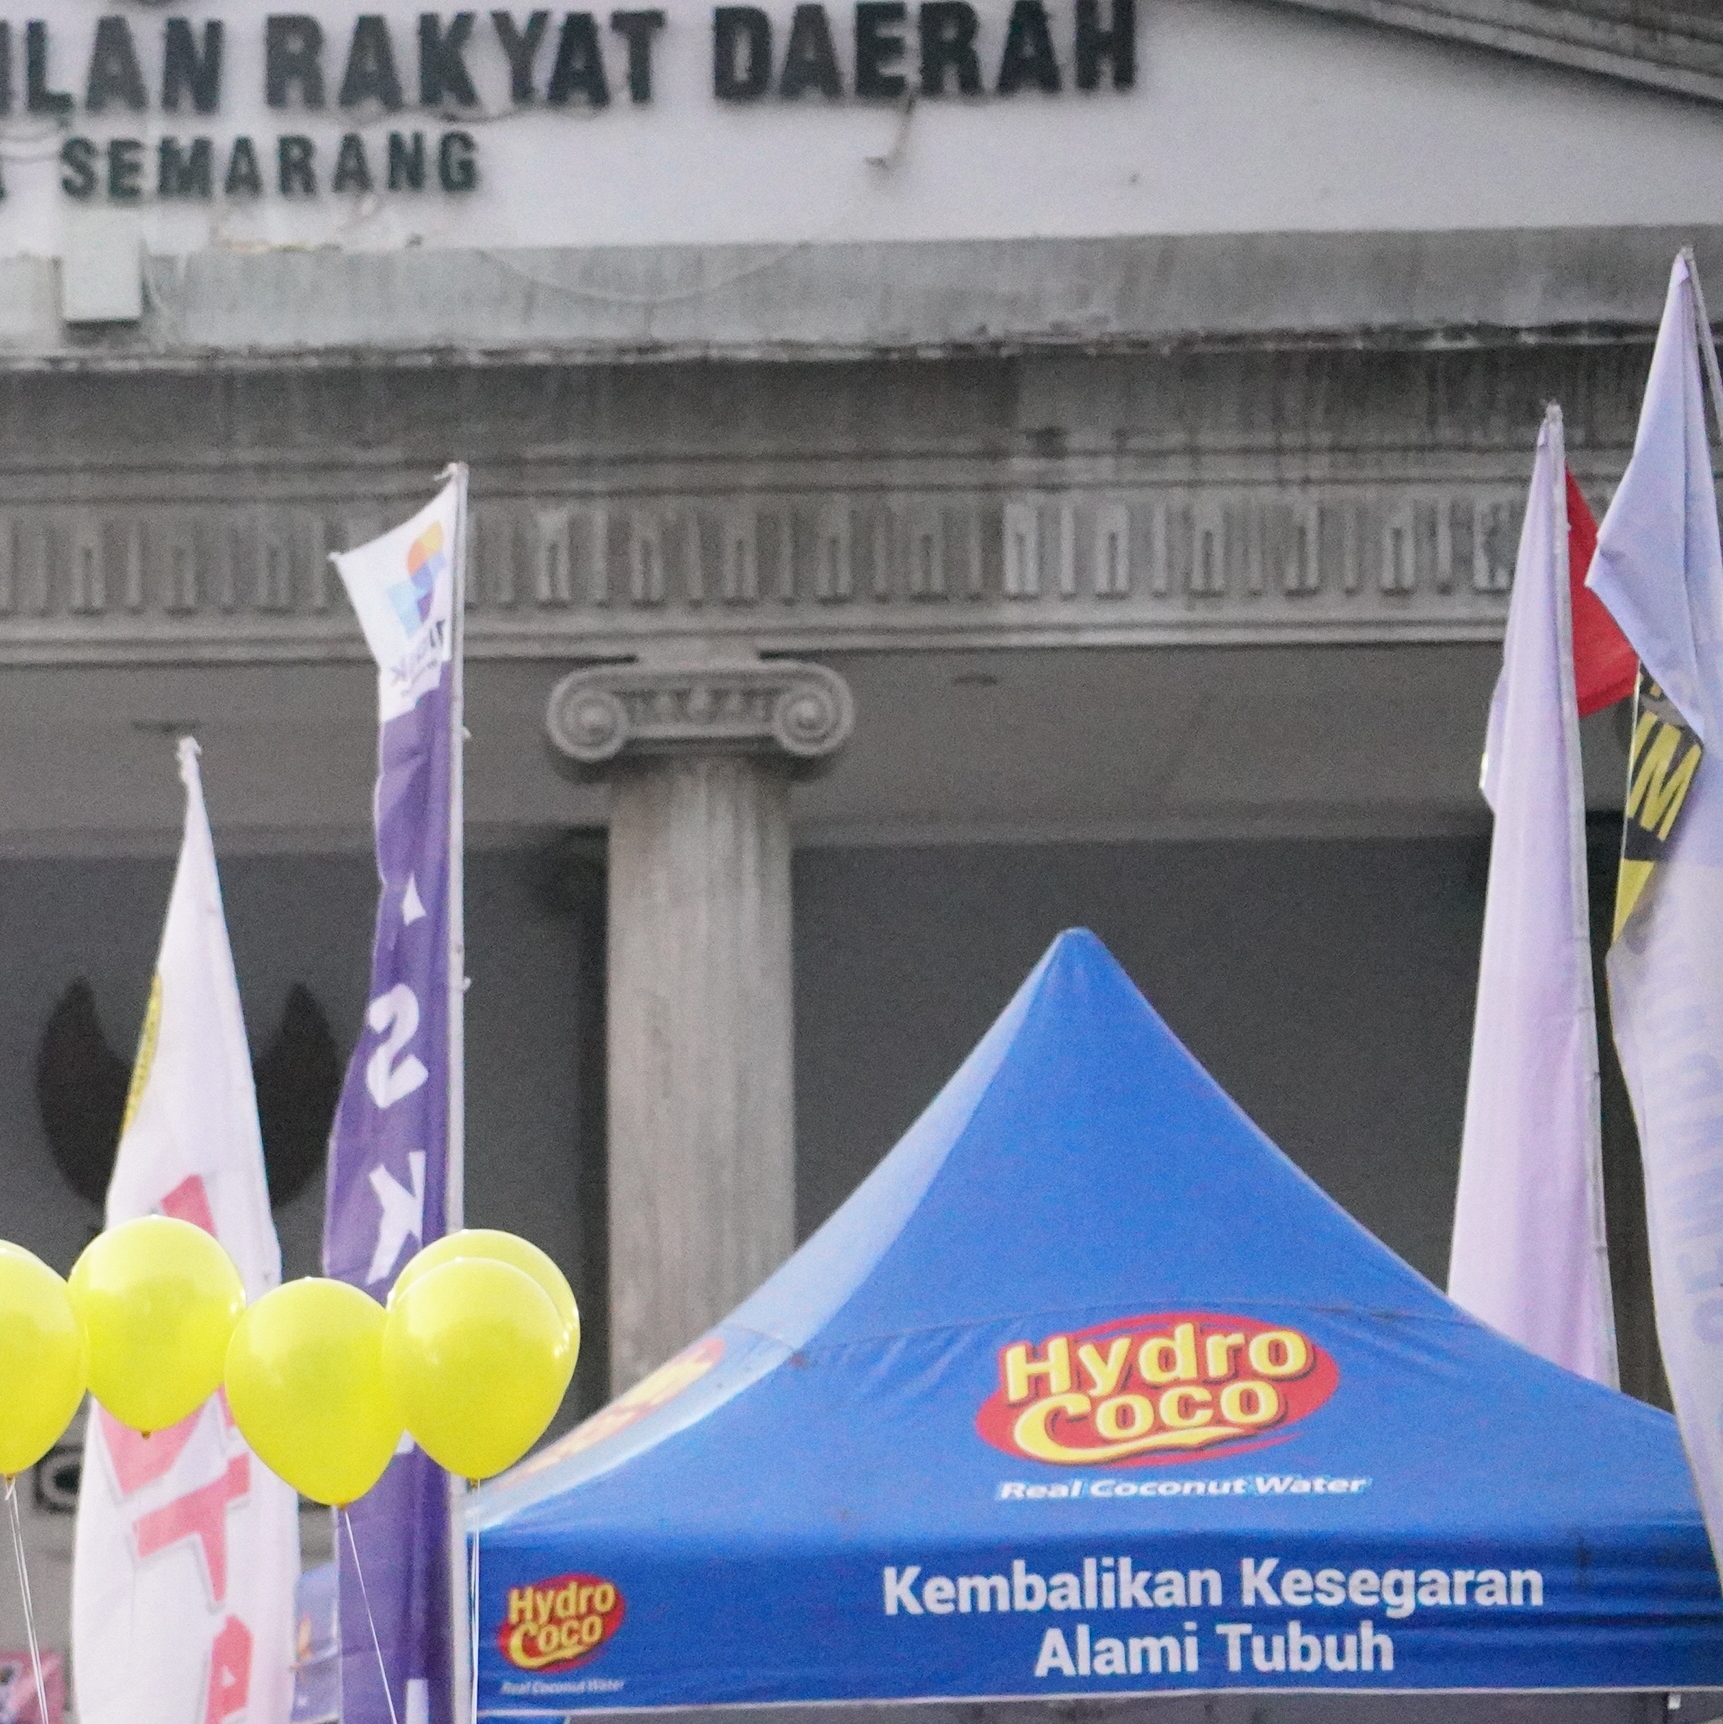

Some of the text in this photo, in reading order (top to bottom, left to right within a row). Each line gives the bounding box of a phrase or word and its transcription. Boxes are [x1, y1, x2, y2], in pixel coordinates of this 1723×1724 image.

[263, 9, 666, 113] RAKYAT
[712, 1, 1139, 102] DAERAH
[60, 129, 478, 202] SEMARANG
[1005, 1321, 1309, 1403] Hydro
[1013, 1378, 1280, 1465] Coco
[1000, 1474, 1368, 1500] Real Coconut Water
[508, 1581, 616, 1624] Hydro
[883, 1556, 1546, 1619] Kembalikan Kesegaran
[509, 1614, 603, 1669] Coco
[1034, 1619, 1395, 1678] Alami Tubuh
